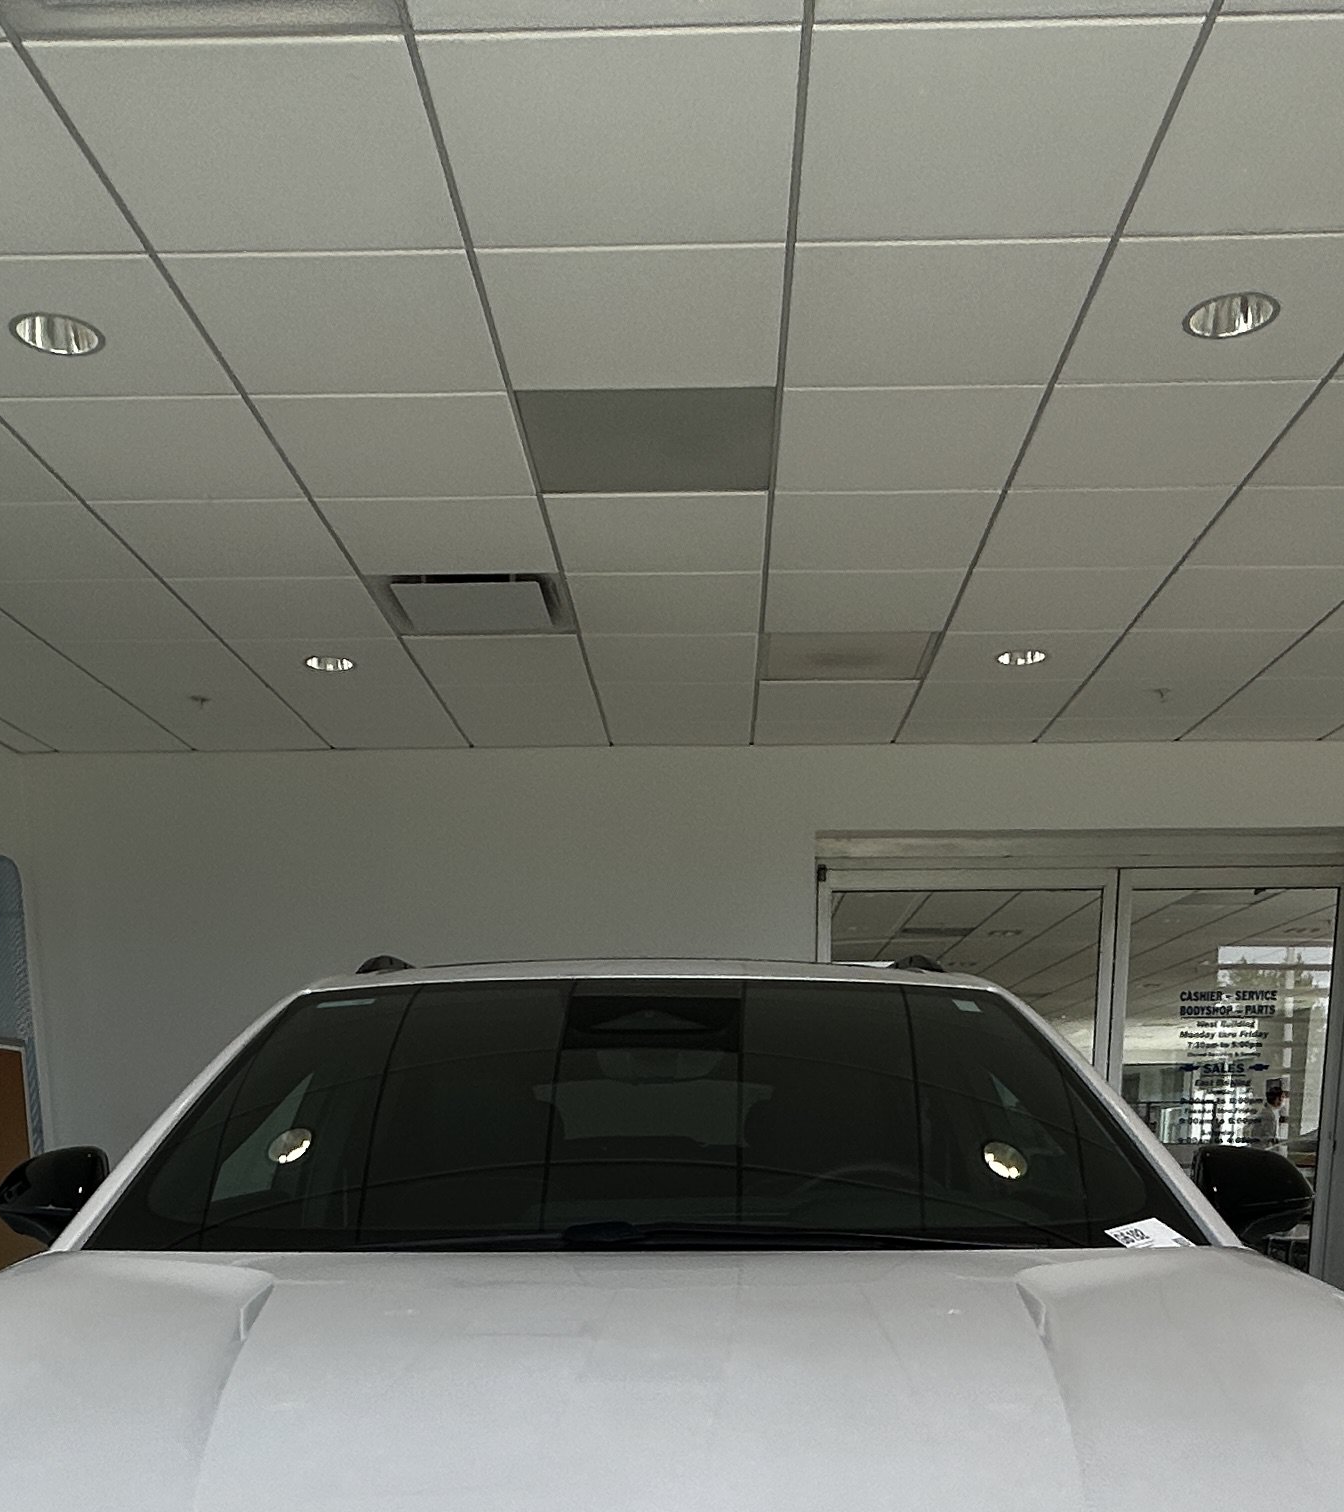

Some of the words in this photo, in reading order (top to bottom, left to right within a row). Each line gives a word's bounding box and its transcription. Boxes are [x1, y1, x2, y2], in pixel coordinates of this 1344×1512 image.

[1180, 991, 1222, 1001] CASHIER
[1235, 990, 1278, 1001] SERVICE
[1180, 1005, 1233, 1016] BODYSHOP
[1244, 1005, 1276, 1016] PARTS
[1179, 1030, 1216, 1039] Monday
[1239, 1030, 1269, 1039] Friday
[1203, 1063, 1244, 1074] SALES
